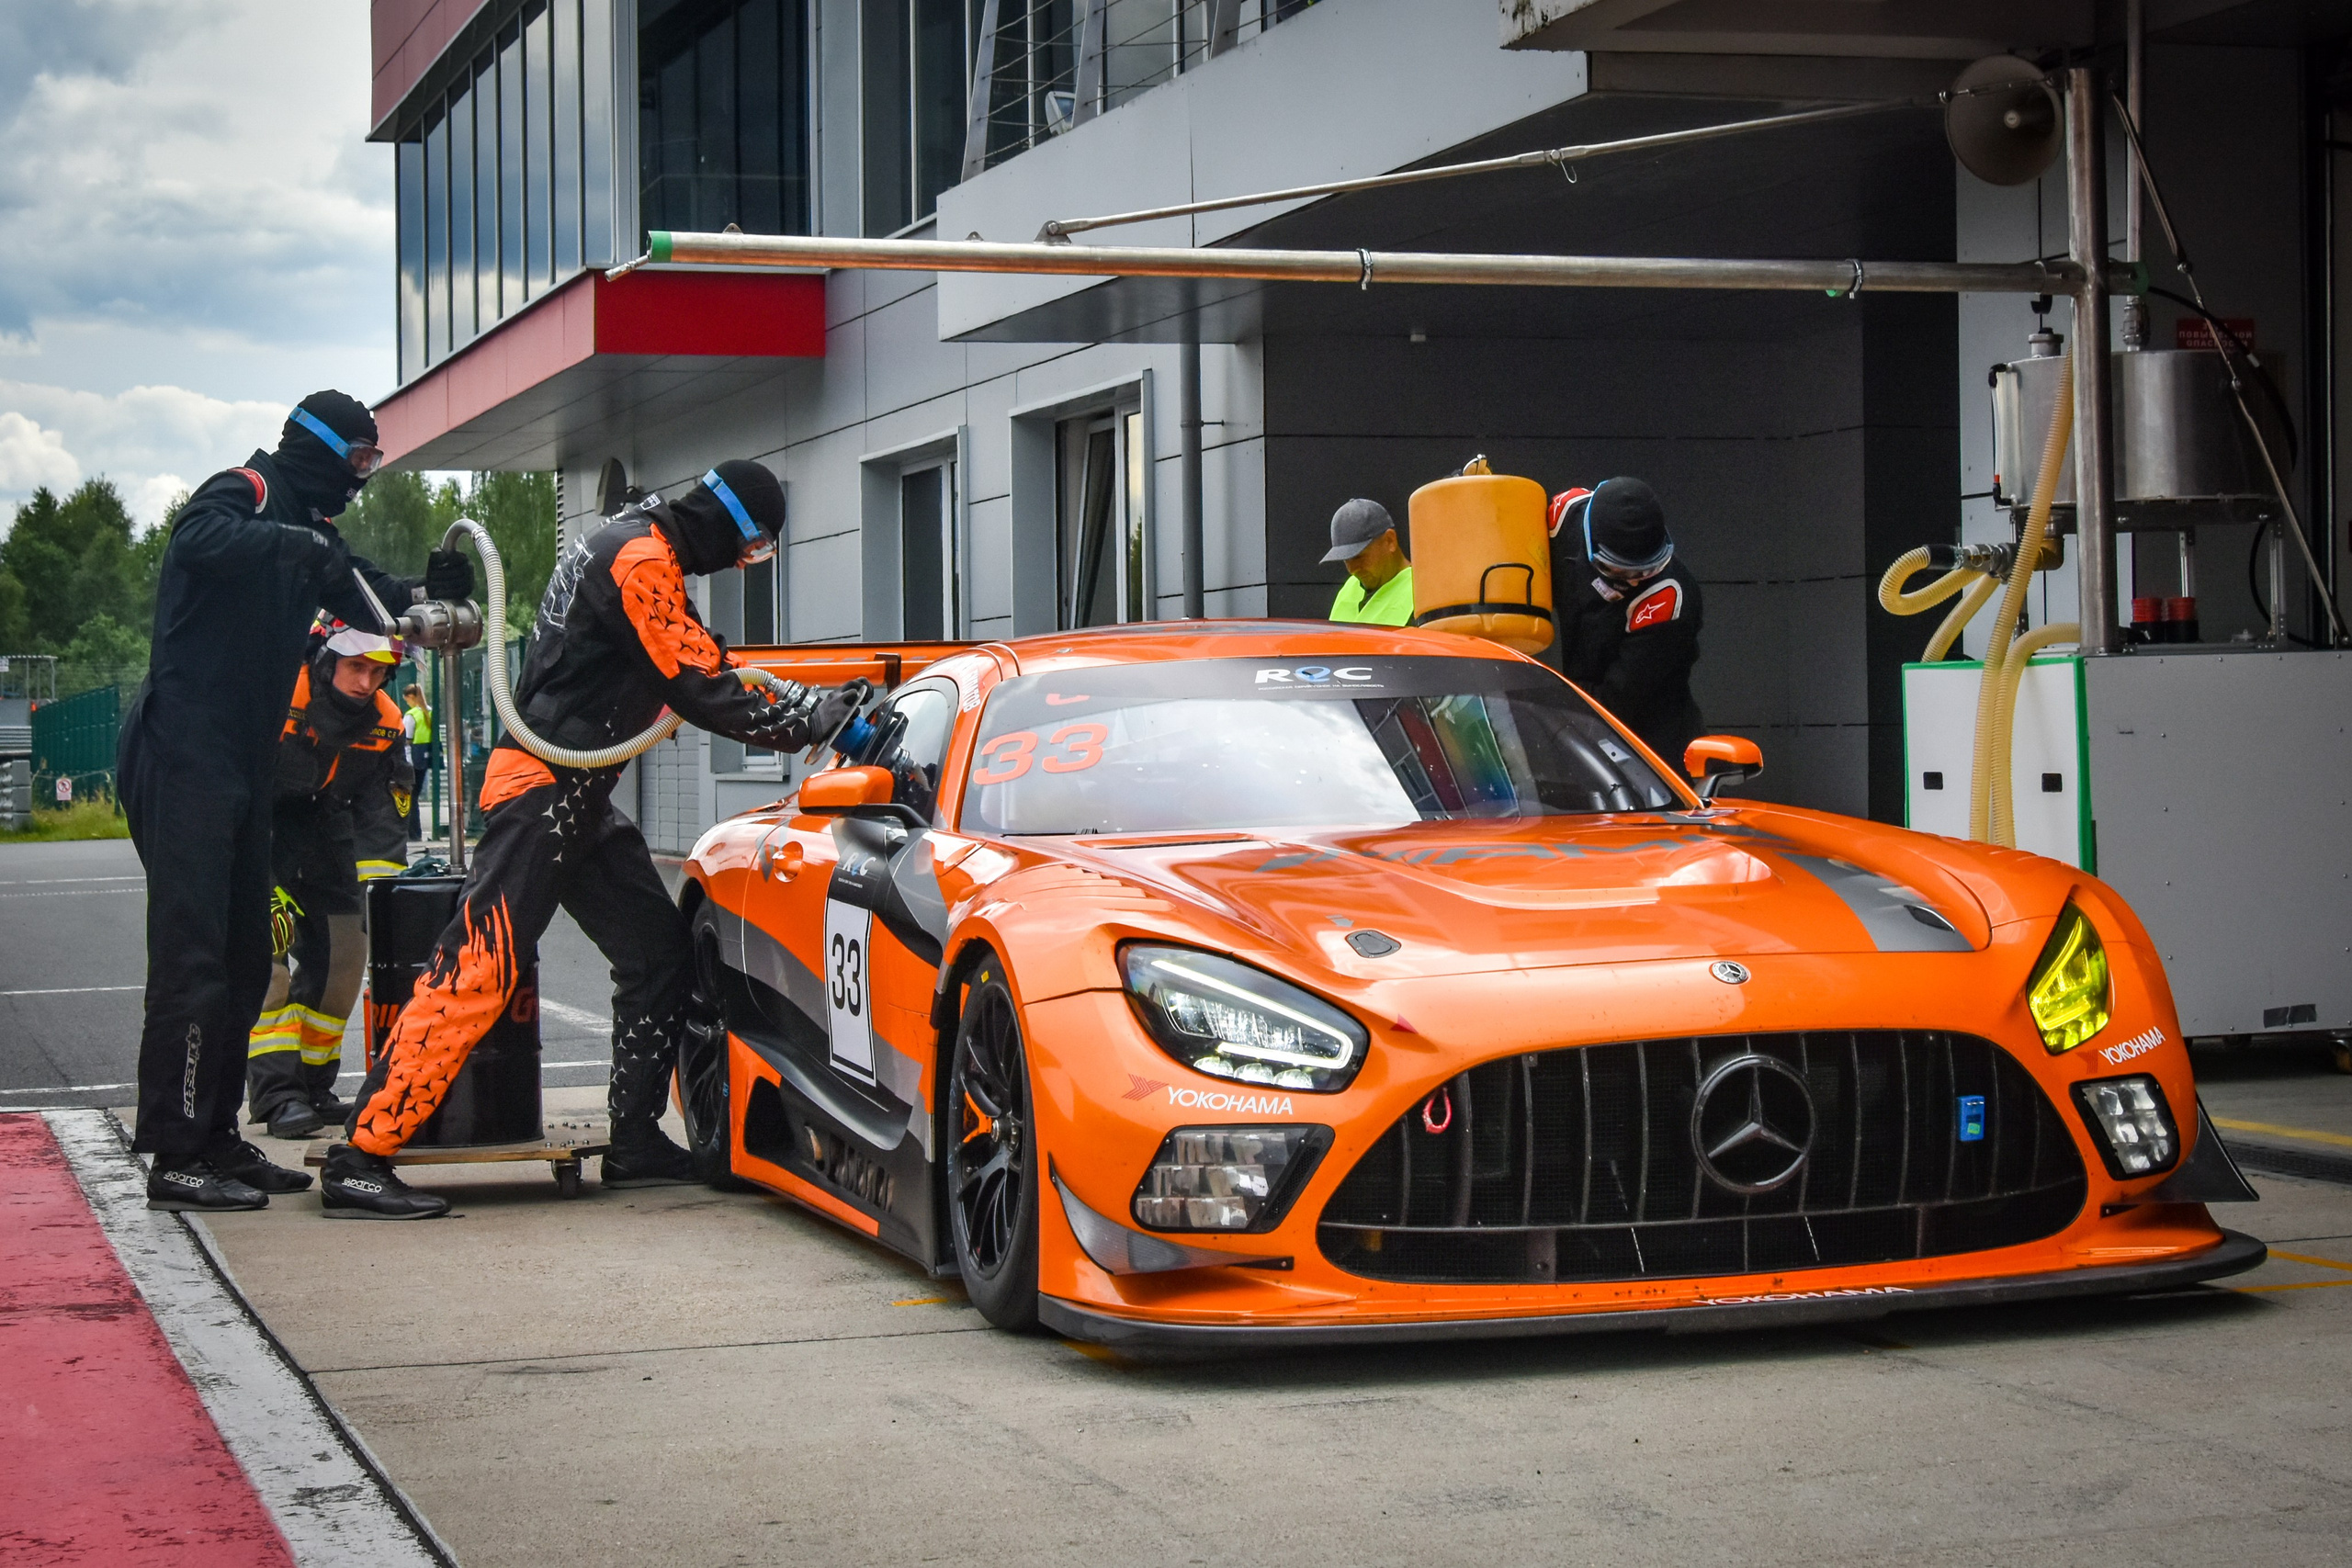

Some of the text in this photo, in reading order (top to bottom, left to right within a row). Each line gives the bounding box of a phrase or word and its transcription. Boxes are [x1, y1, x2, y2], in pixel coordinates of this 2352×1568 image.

[972, 722, 1109, 785] 33
[831, 932, 861, 1017] 33
[2098, 1025, 2165, 1066] YOKOHAMA
[1168, 1086, 1293, 1115] YOKOHAMA
[1691, 1286, 1915, 1305] YOKOHAMA
